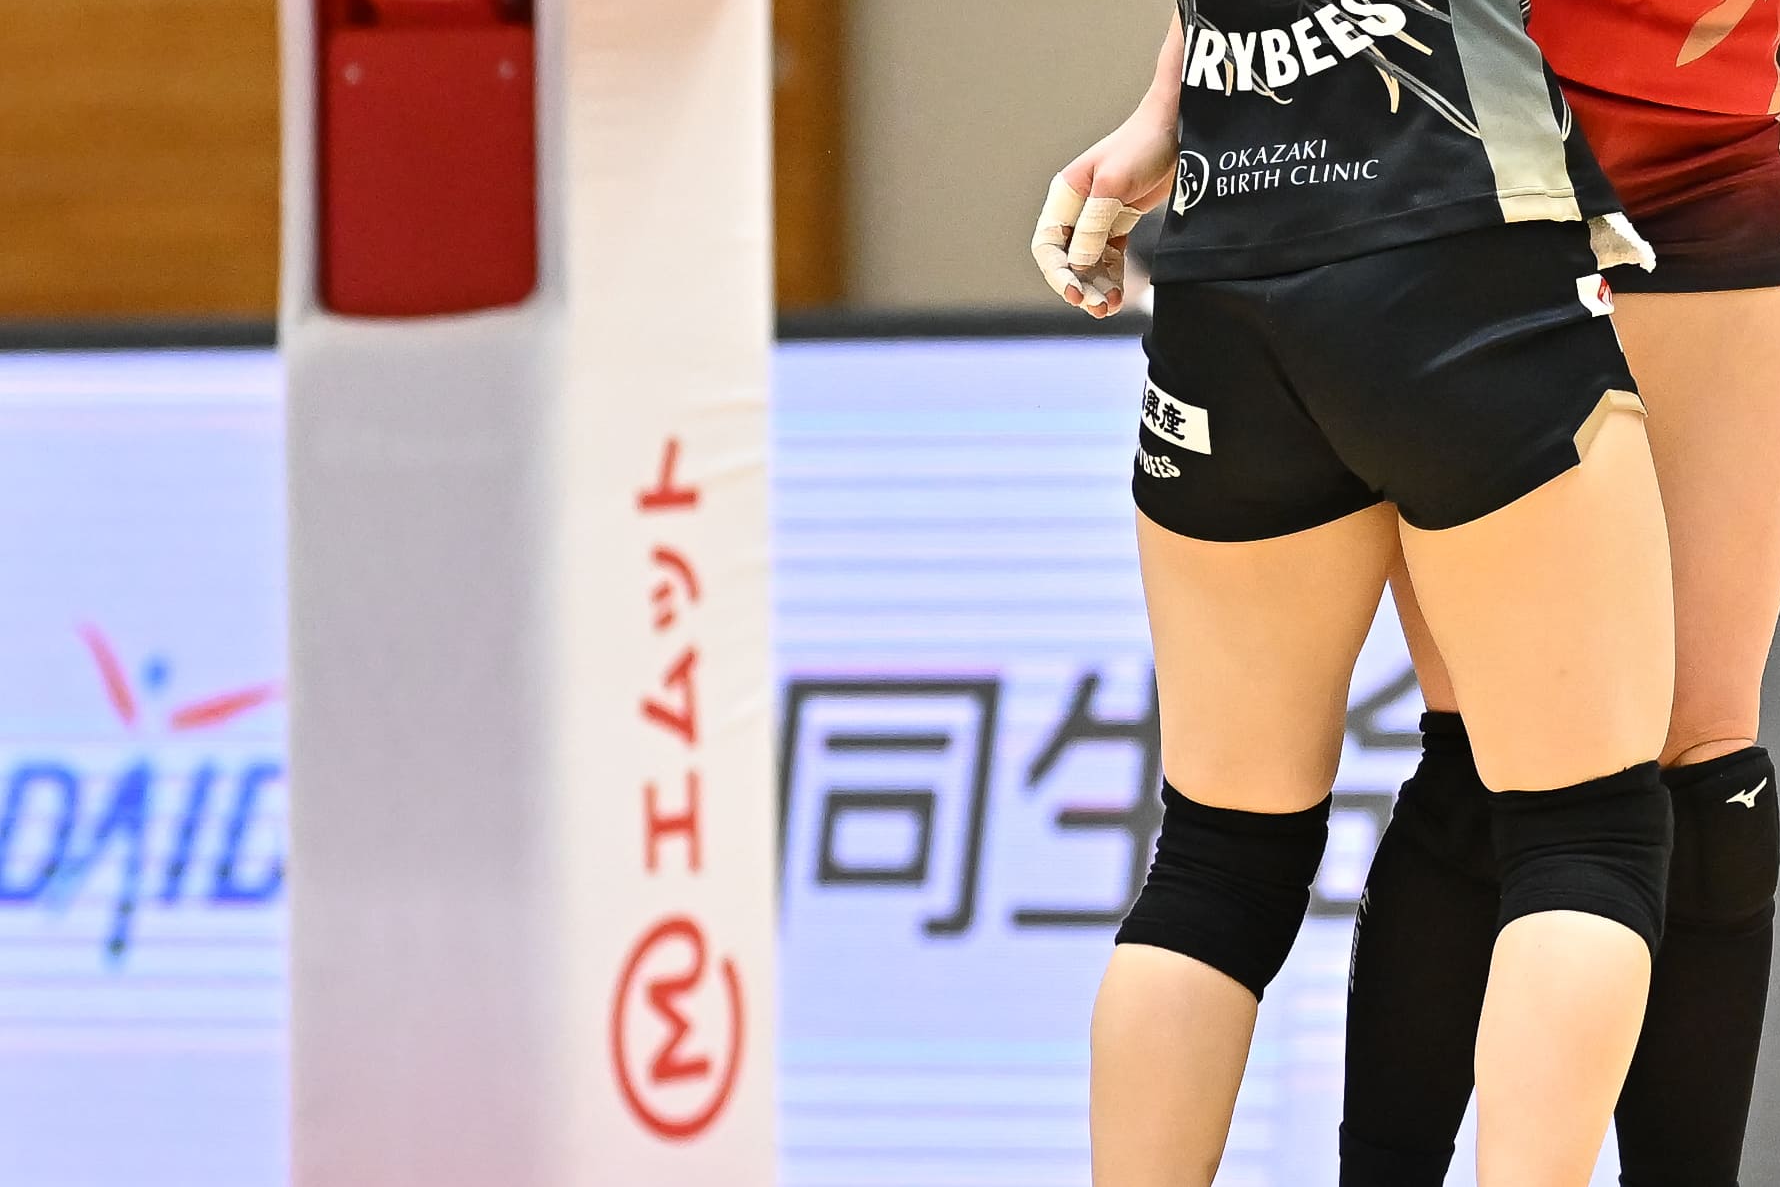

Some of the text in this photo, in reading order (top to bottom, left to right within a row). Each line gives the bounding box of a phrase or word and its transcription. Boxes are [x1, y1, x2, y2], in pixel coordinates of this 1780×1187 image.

[1218, 139, 1327, 171] OKAZAKI
[1216, 159, 1379, 197] BIRTH CLINIC
